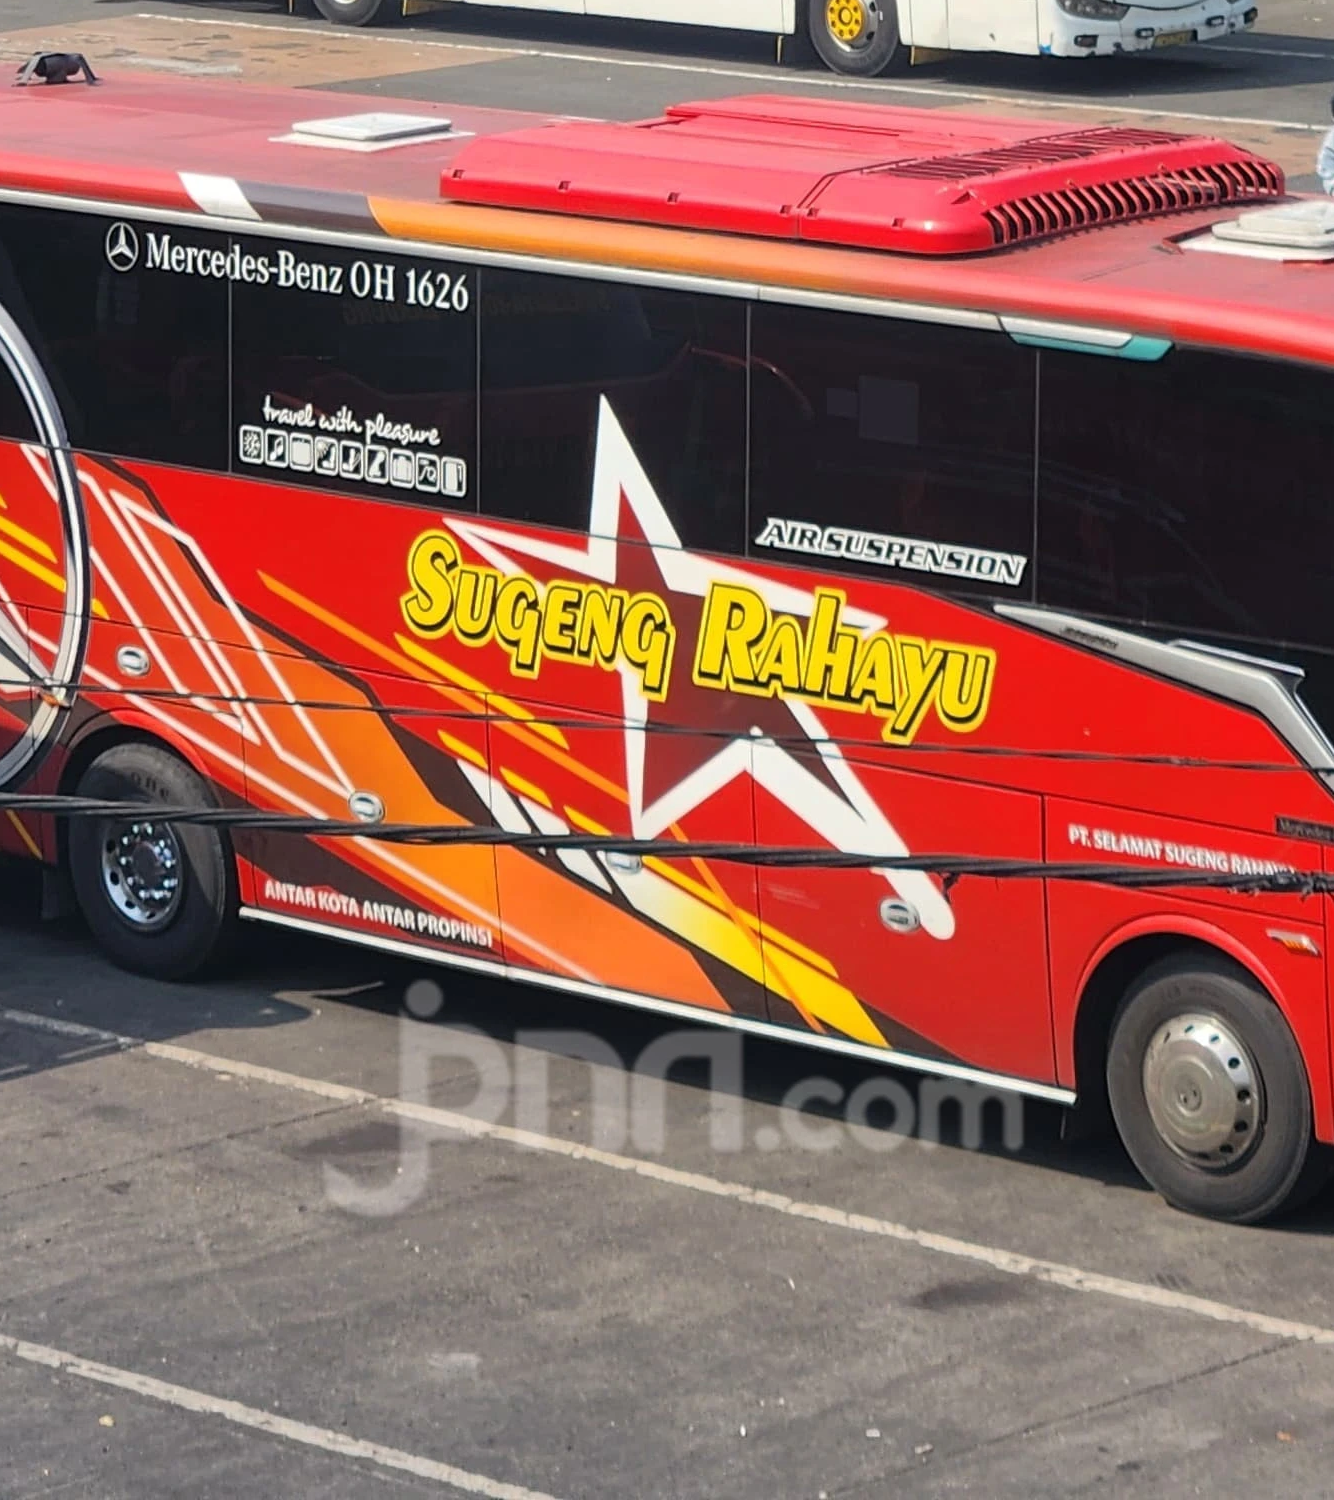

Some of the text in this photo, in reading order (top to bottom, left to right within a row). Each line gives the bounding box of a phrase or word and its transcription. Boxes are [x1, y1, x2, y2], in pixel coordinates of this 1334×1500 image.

[145, 232, 343, 295] Mercedes-Benz
[350, 260, 394, 301] OH
[405, 267, 469, 312] 1626
[263, 394, 441, 447] travel with pleasure
[1068, 824, 1092, 848] PT.
[1093, 830, 1162, 860] SELAMAT
[1164, 841, 1228, 872] SUGENG
[265, 879, 493, 948] ANTAR KOTA ANTAR PROPINSI
